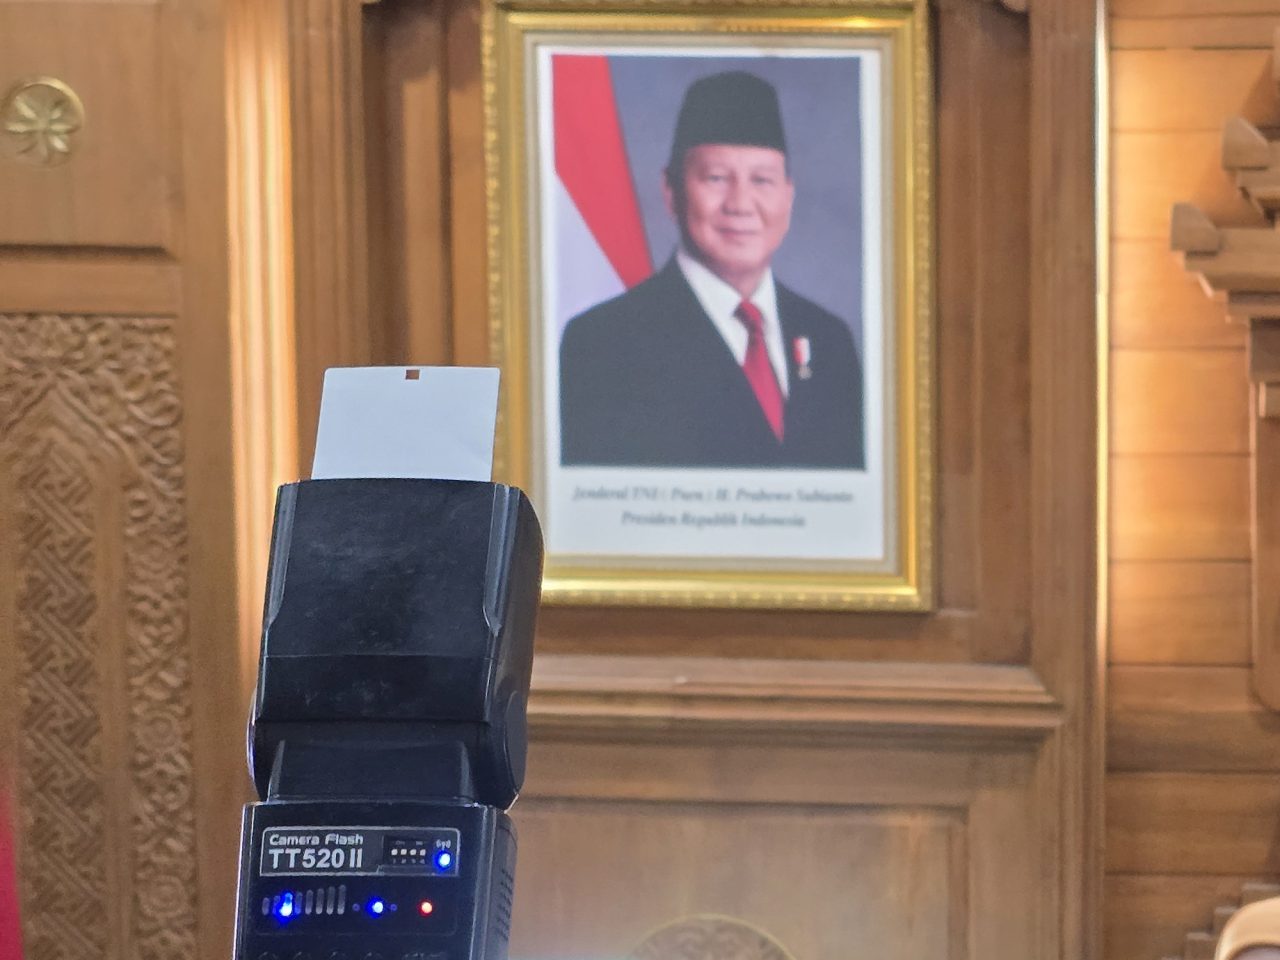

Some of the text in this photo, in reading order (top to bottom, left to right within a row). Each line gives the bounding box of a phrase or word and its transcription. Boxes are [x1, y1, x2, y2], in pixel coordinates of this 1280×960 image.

[742, 512, 806, 527] Indonesia
[269, 833, 364, 846] Camera Flash
[268, 848, 345, 869] TT520
